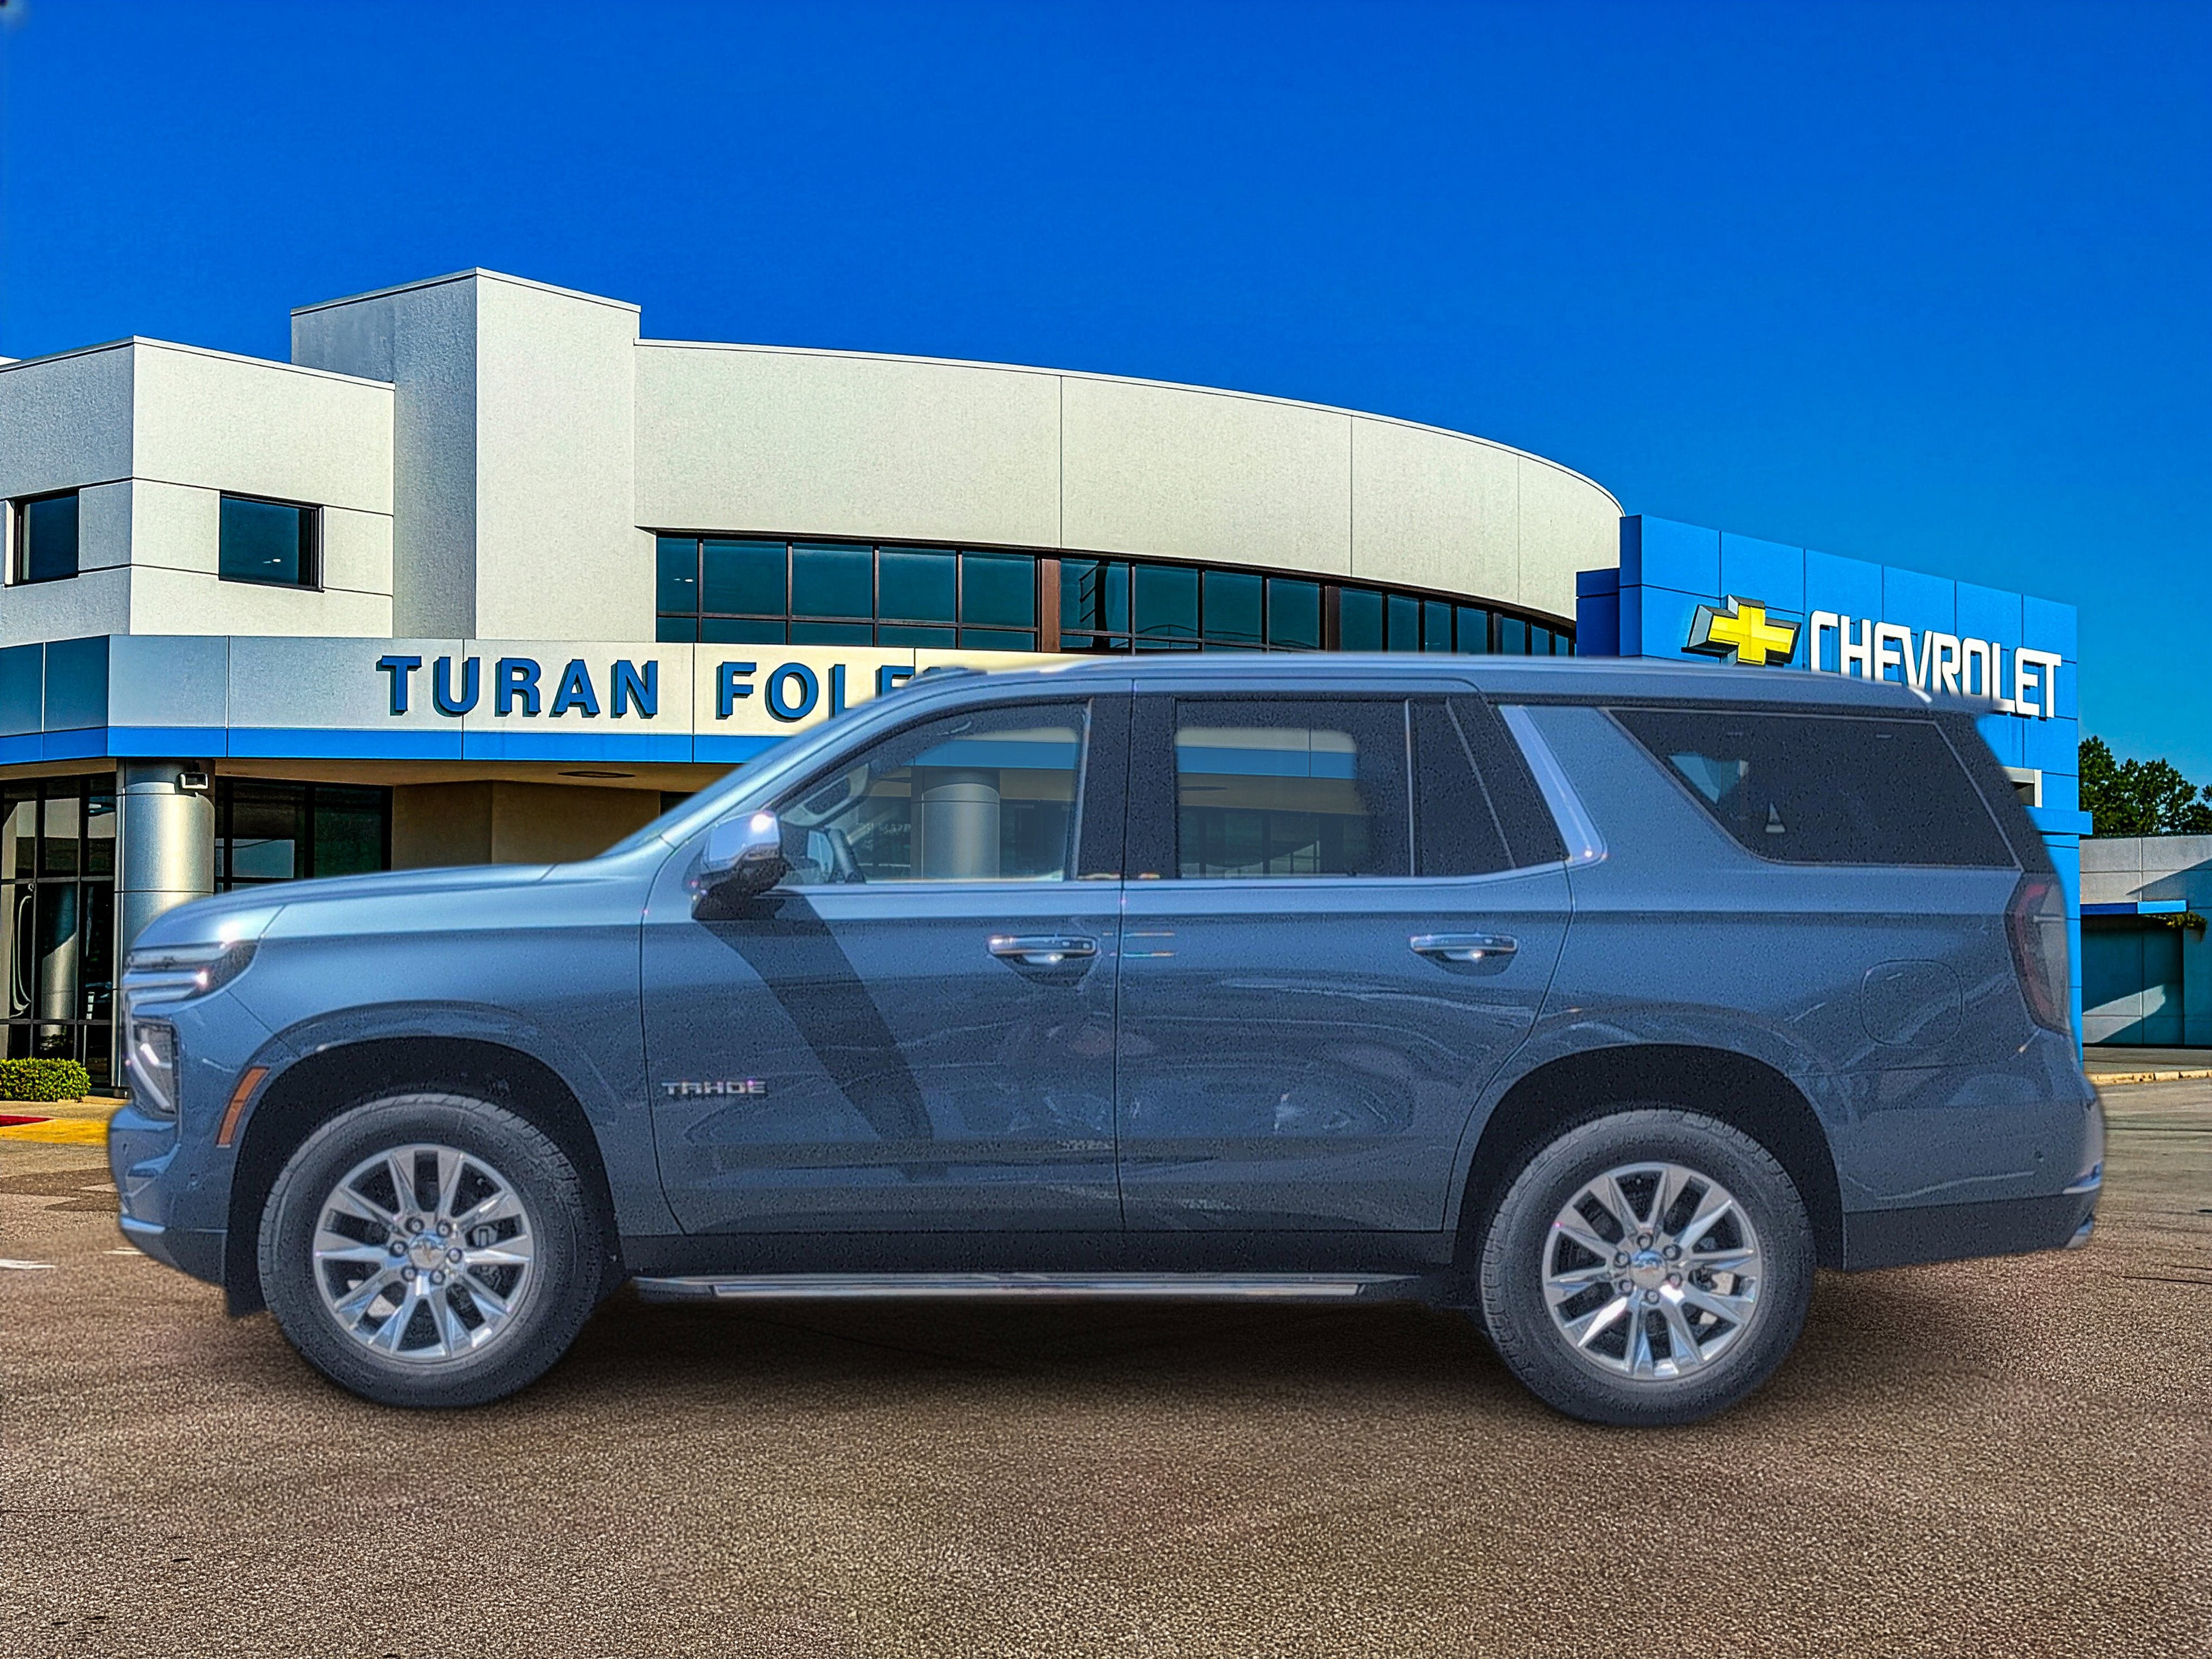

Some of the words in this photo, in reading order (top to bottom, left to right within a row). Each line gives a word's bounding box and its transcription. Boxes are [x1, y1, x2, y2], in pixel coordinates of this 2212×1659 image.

[376, 655, 658, 719] TURAN
[716, 661, 969, 723] FOL
[1810, 610, 2061, 718] CHEVROLET
[661, 1081, 766, 1095] TAHOE
